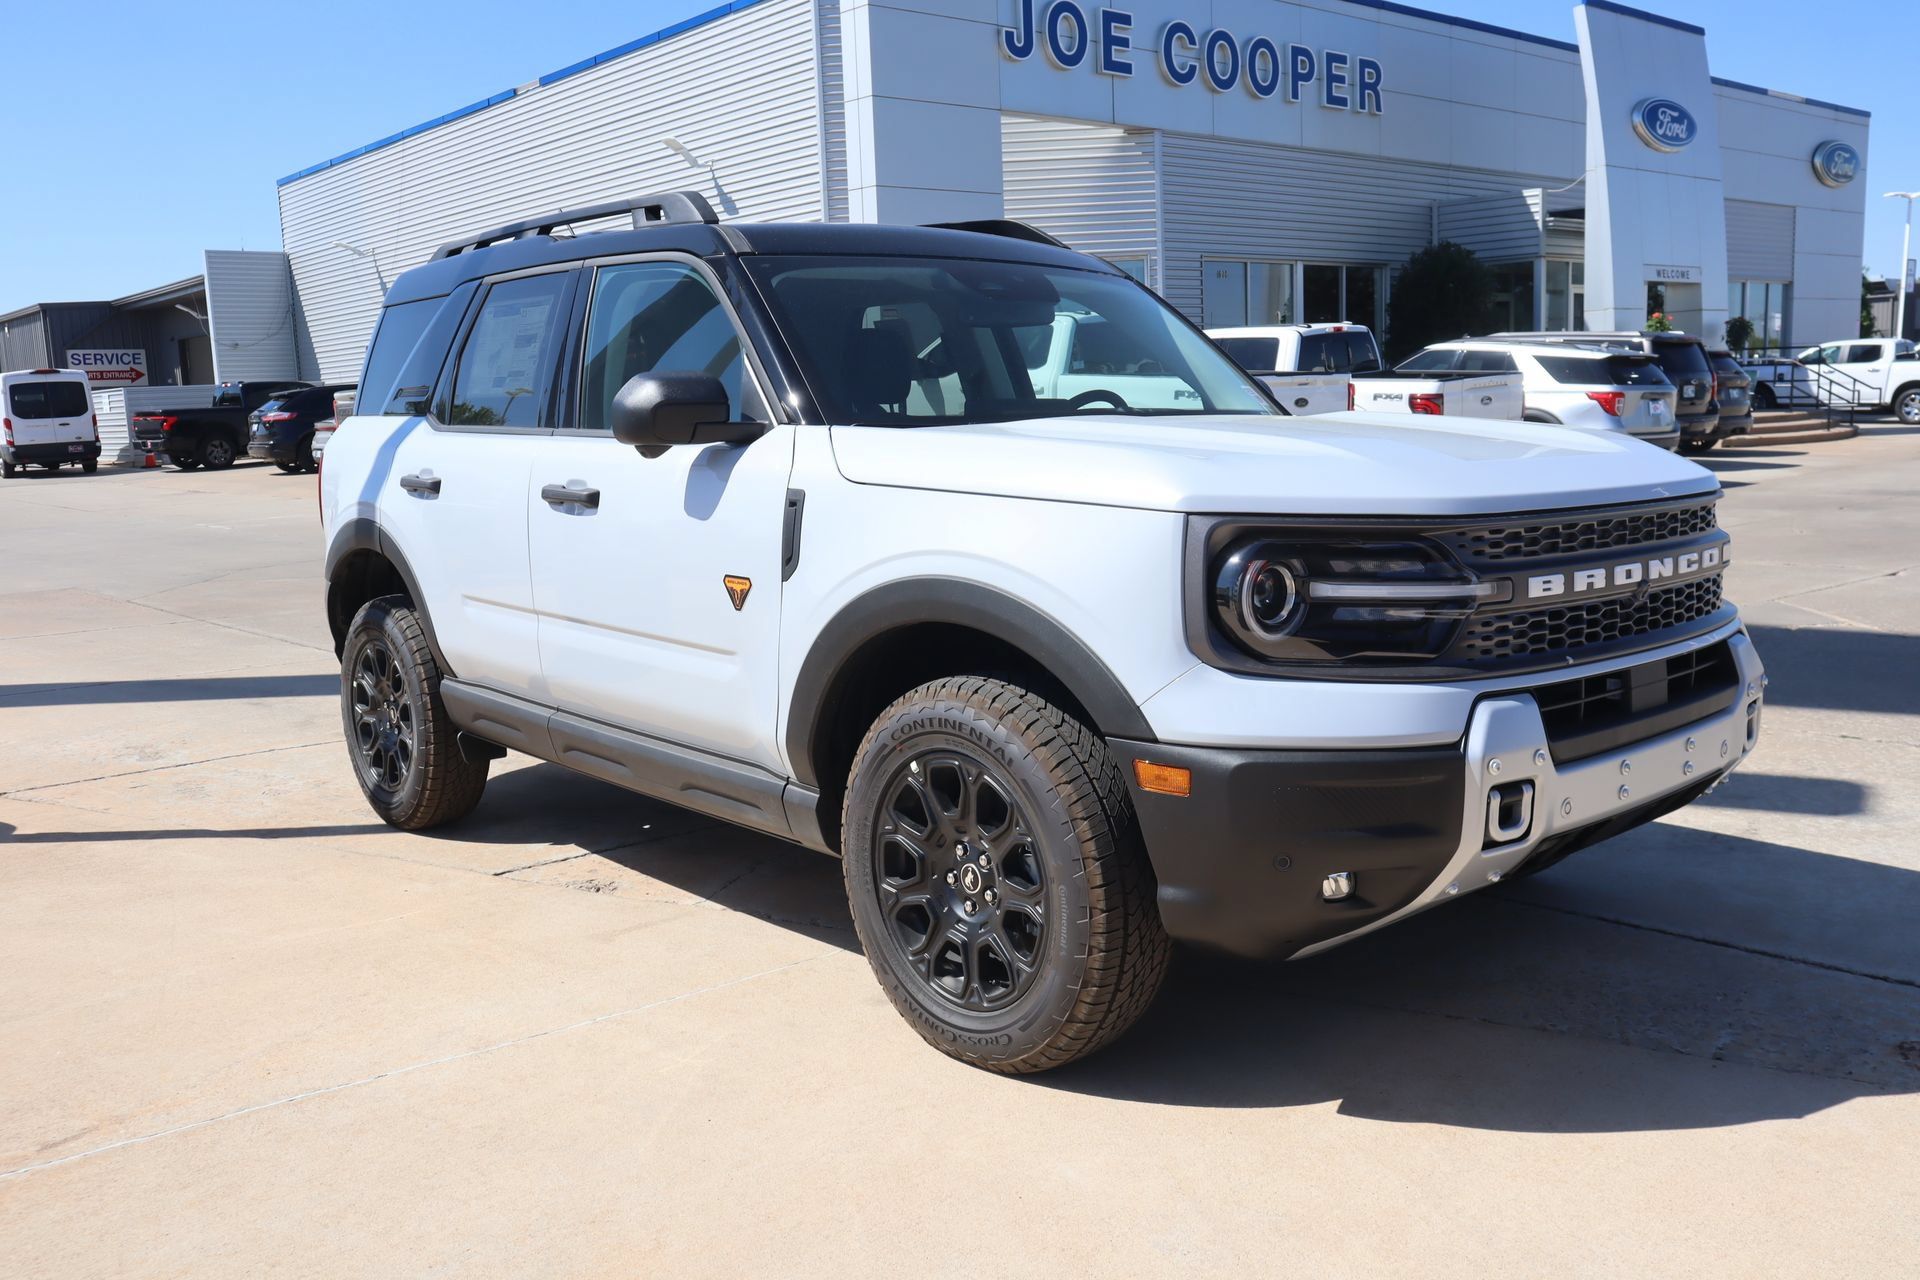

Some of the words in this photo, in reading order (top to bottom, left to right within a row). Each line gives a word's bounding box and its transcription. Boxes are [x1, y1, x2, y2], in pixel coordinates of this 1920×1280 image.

[1002, 0, 1134, 77] JOE
[1160, 20, 1384, 115] COOPER
[1656, 107, 1688, 139] Ford
[1656, 269, 1691, 280] WELCOME
[70, 353, 142, 365] SERVICE
[103, 371, 136, 379] ENTRANCE
[1373, 393, 1403, 401] FX4
[1528, 547, 1719, 598] BRONCO
[890, 717, 1014, 768] CONTINENTAL
